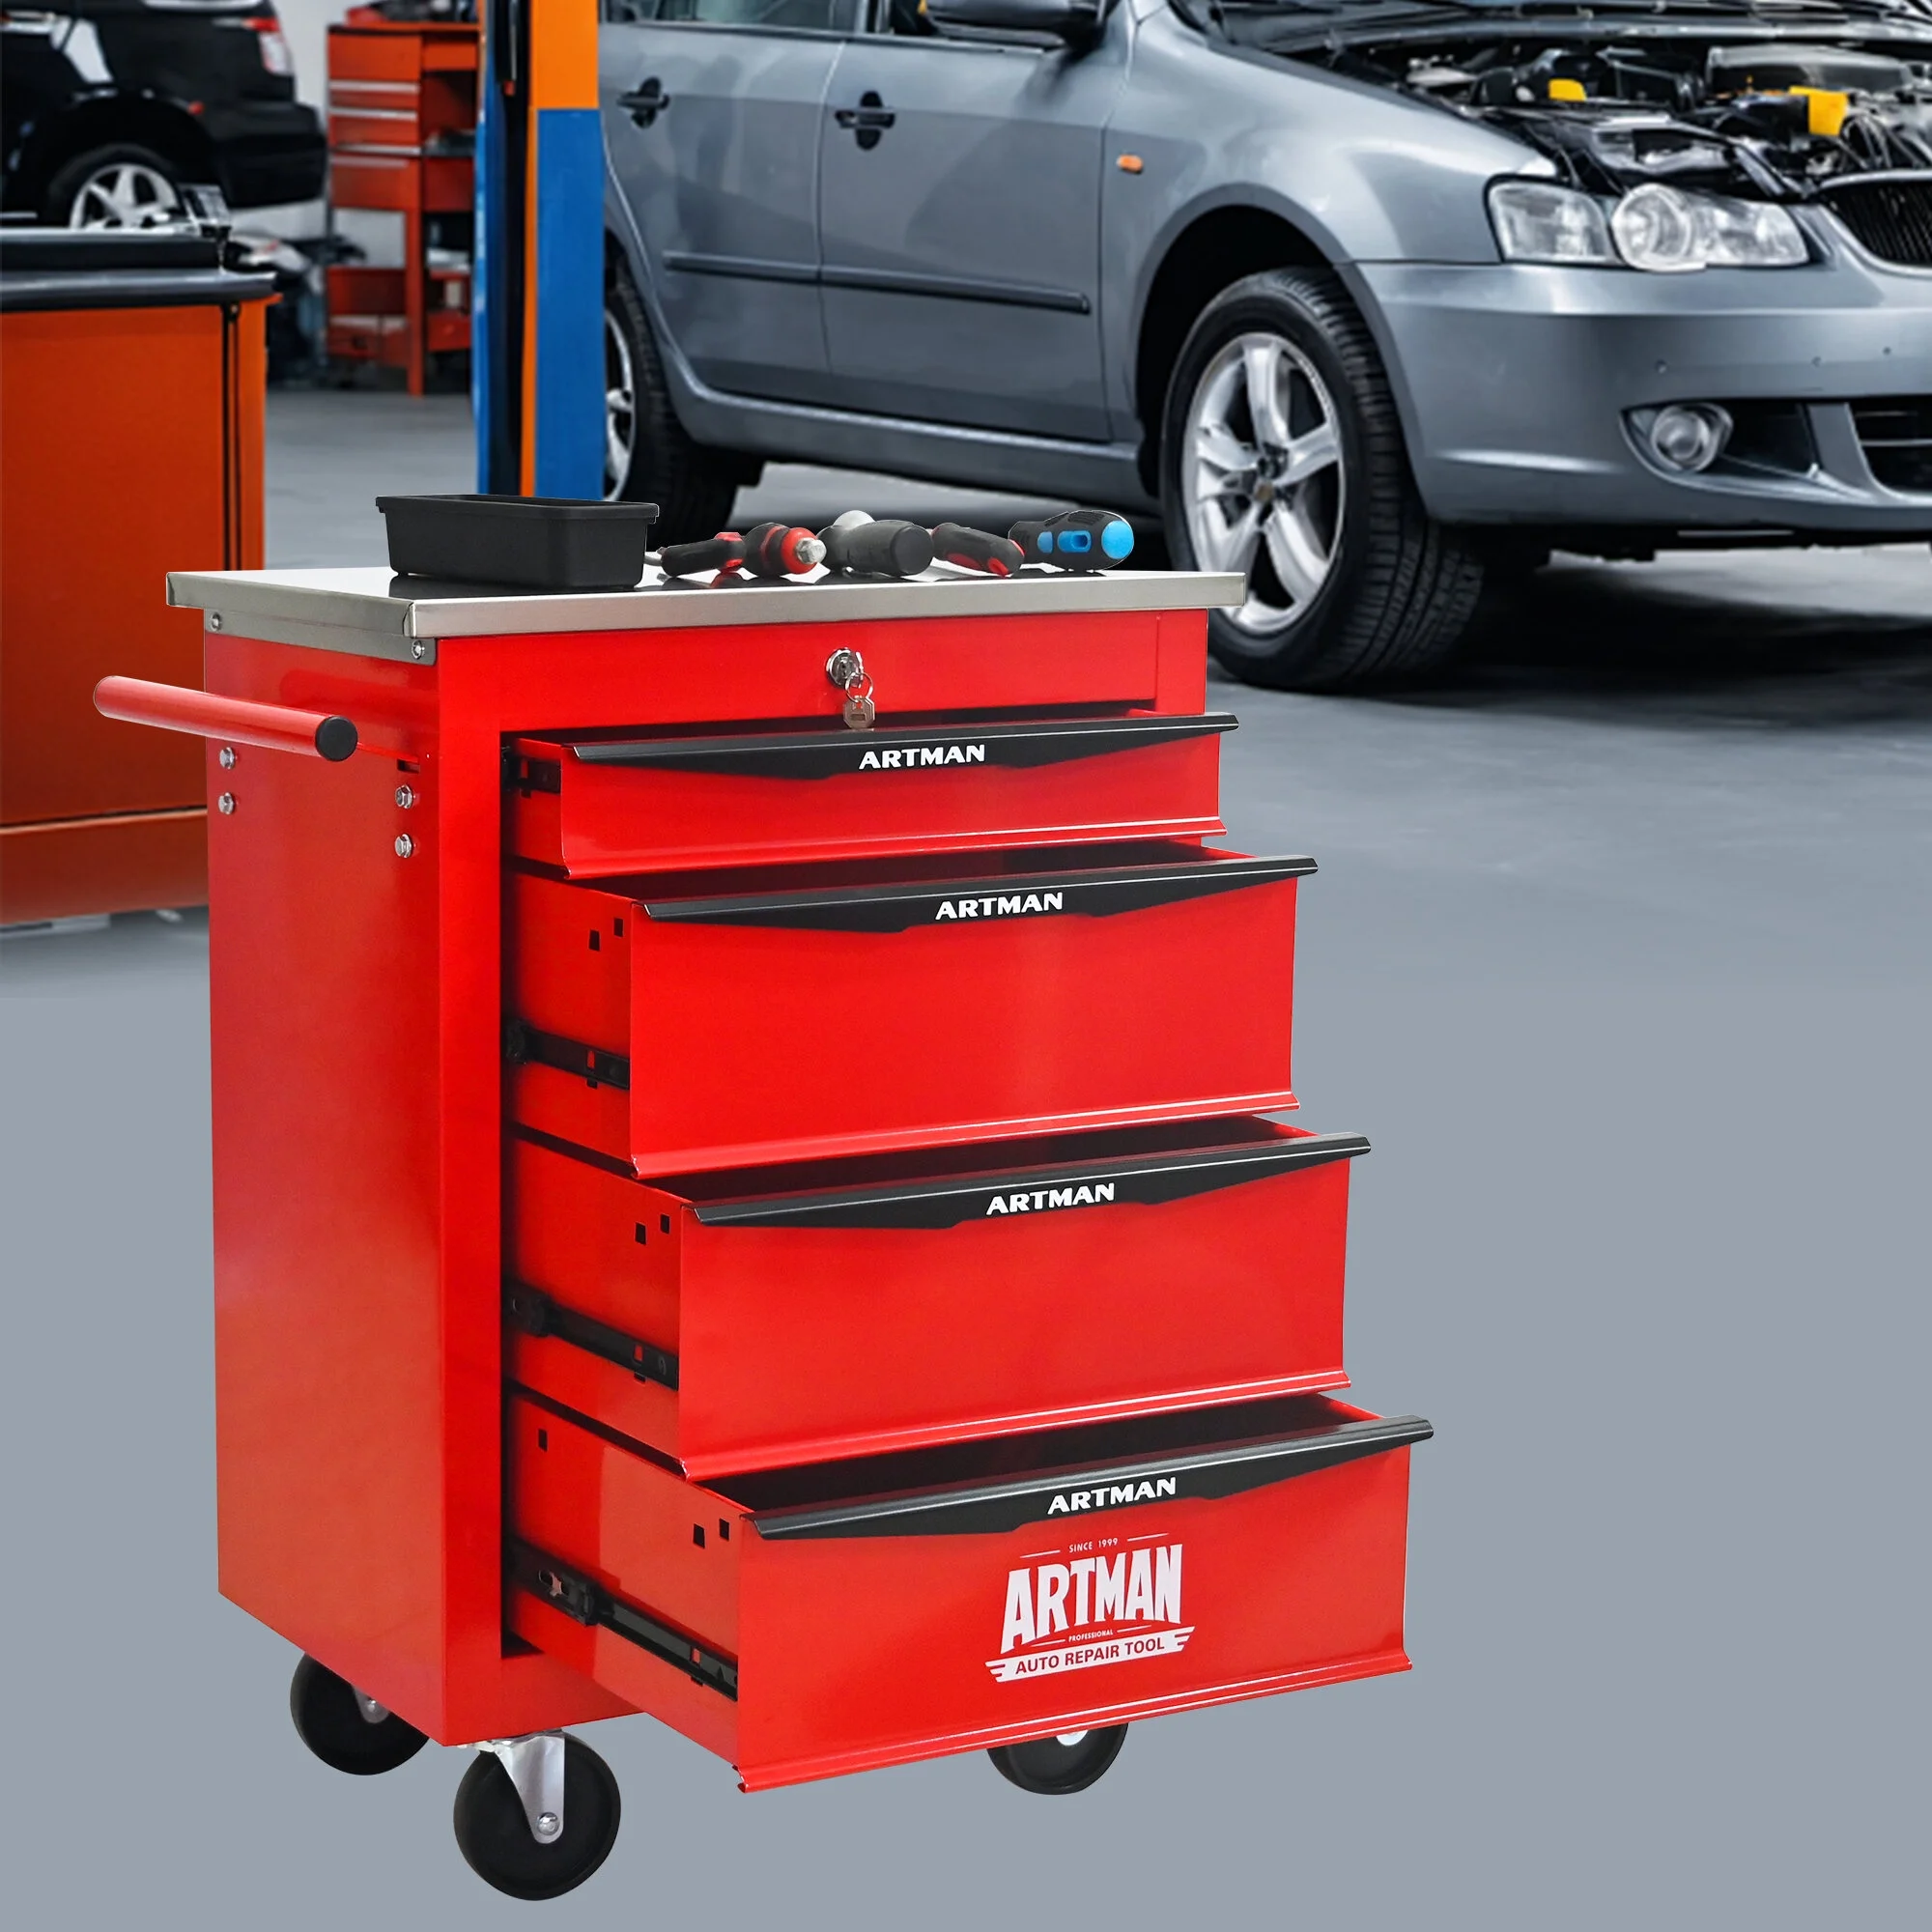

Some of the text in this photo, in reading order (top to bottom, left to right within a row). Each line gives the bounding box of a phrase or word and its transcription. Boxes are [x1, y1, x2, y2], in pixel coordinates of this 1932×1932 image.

[859, 744, 985, 770] ARTMAN
[935, 893, 1063, 921] ARTMAN
[986, 1182, 1115, 1215] ARTMAN
[1047, 1477, 1177, 1515] ARTMAN
[1068, 1537, 1119, 1553] SINCE 1999
[1000, 1544, 1183, 1655] ARTMAN
[1068, 1629, 1114, 1642] PROFESSIONAL
[1015, 1637, 1165, 1675] AUTO REPAIR TOOL
